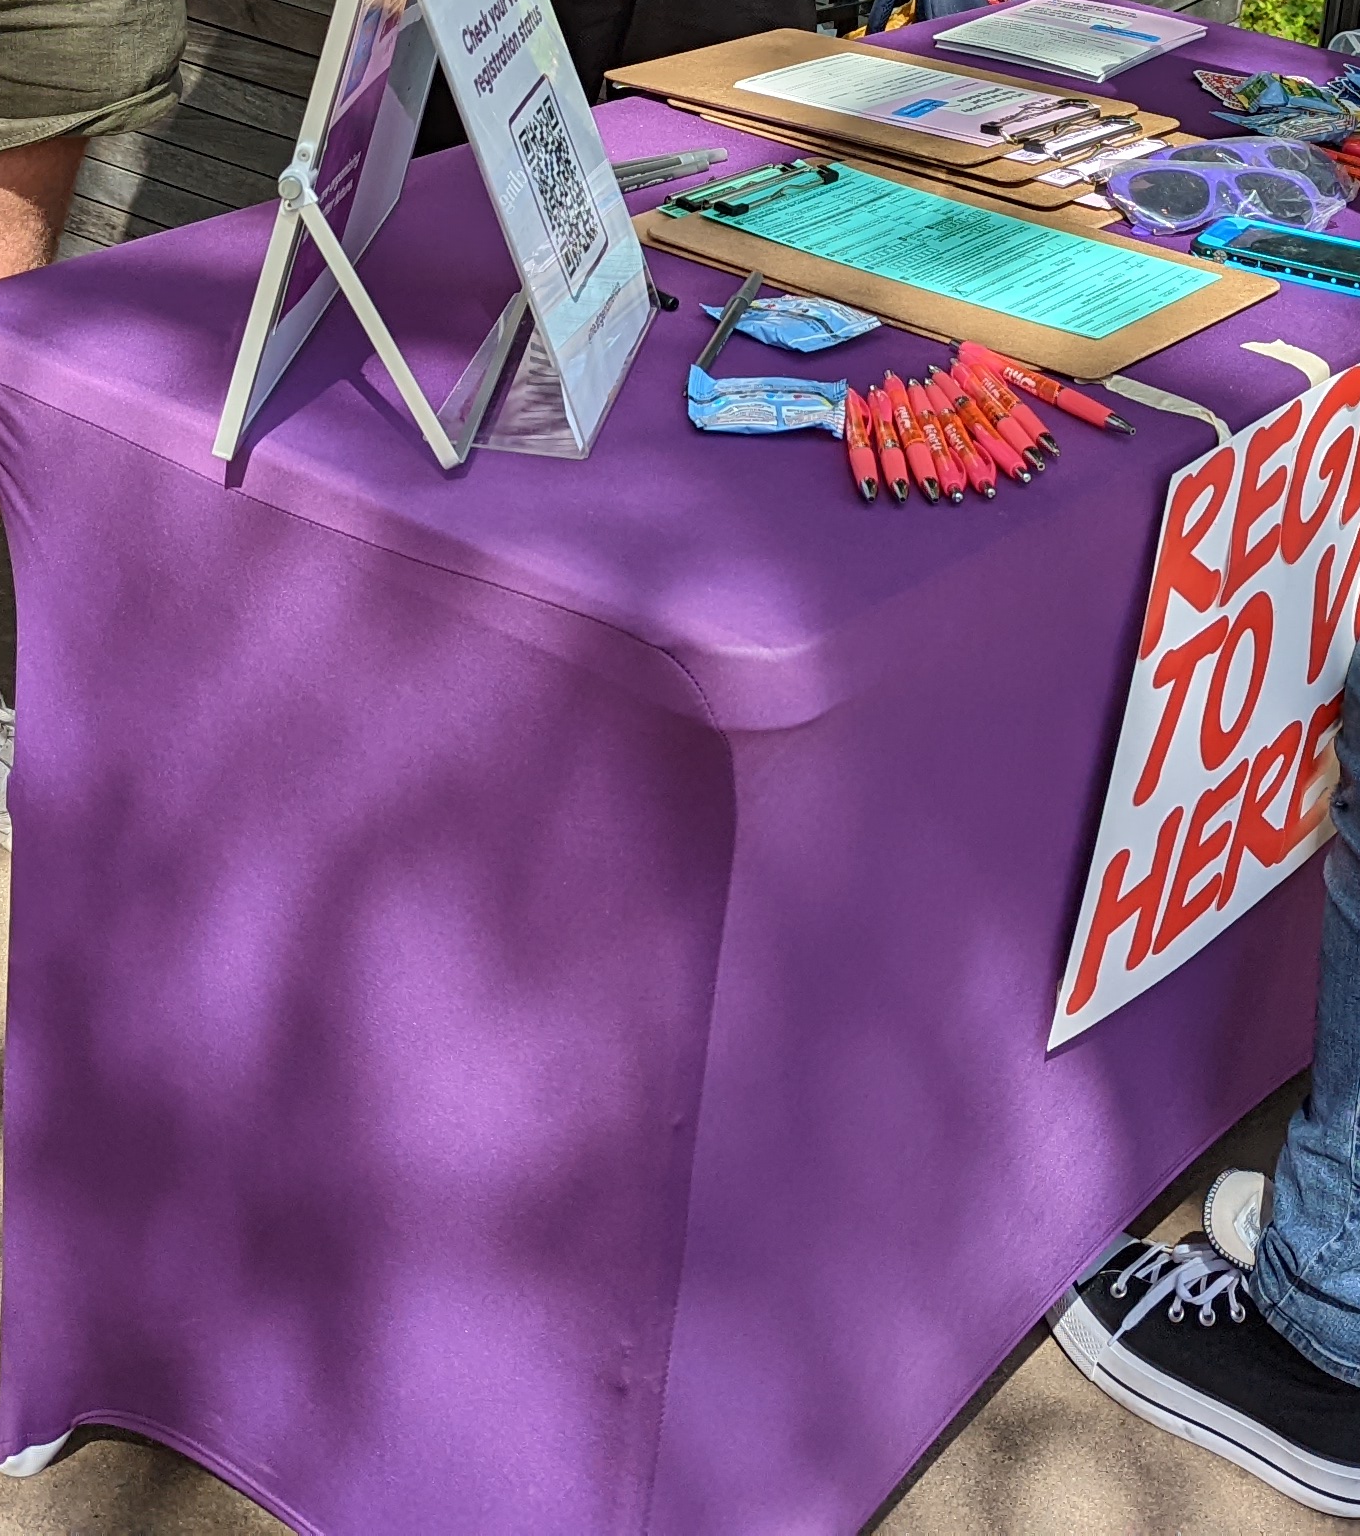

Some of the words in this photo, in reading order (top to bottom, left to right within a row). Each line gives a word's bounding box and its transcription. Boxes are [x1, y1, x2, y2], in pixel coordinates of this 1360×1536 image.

[462, 10, 493, 55] Check
[473, 31, 522, 98] registration
[517, 5, 543, 43] status
[1133, 590, 1274, 807] TO
[1065, 687, 1344, 1015] HERE
